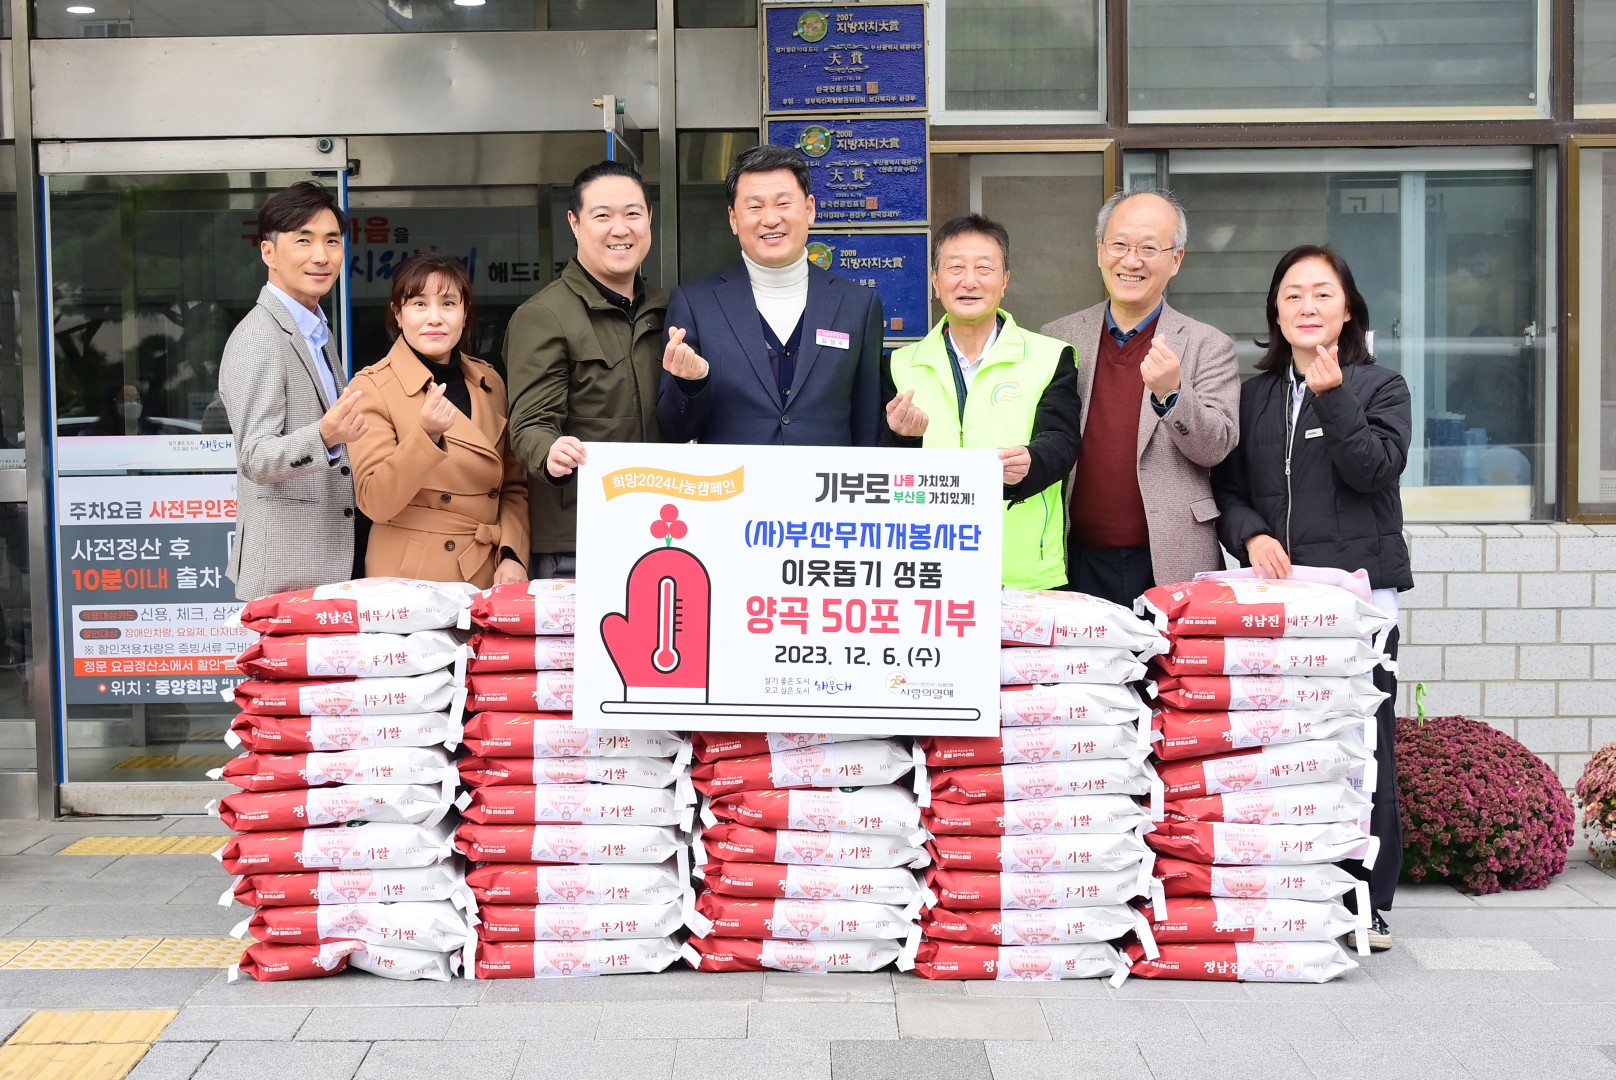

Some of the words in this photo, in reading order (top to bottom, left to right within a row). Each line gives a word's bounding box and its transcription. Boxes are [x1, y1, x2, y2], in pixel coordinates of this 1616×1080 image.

[836, 130, 853, 138] 2008
[840, 249, 857, 257] 2009
[611, 472, 737, 497] 희망2024나눔캠페인
[815, 472, 891, 505] 기부로
[893, 474, 915, 488] 나를
[917, 474, 960, 489] 가치있게
[893, 490, 927, 505] 부산을
[928, 491, 975, 506] 가치있게!
[69, 501, 143, 520] 주차요금
[149, 499, 238, 519] 사전무인정
[744, 519, 982, 552] (사)부산무지개봉사단
[70, 537, 162, 561] 사전정산
[168, 536, 191, 560] 후
[71, 567, 169, 591] 10분이내
[176, 566, 222, 589] 출차
[781, 559, 883, 588] 이웃돕기
[893, 560, 943, 589] 성품
[140, 607, 172, 622] 신용,
[176, 606, 208, 621] 체크,
[315, 612, 354, 625] 정남진
[359, 607, 410, 622] 메뚜기쌀
[745, 595, 810, 635] 양곡
[821, 598, 900, 635] 50포
[914, 599, 977, 638] 기부
[1241, 614, 1280, 628] 정남진
[124, 627, 174, 638] 장애인차량,
[176, 627, 208, 638] 요일제,
[209, 627, 248, 637] 다자녀등
[98, 644, 175, 656] 할인적용차량은
[178, 642, 222, 655] 증빙서류
[774, 644, 833, 665] 2023.
[844, 646, 871, 666] 12.
[83, 660, 107, 673] 정문
[110, 660, 193, 673] 요금정산소에서
[196, 659, 220, 671] 할인
[110, 680, 141, 696] 위치
[154, 679, 218, 695] 중앙현관
[764, 676, 779, 685] 살기
[780, 676, 794, 685] 좋은
[796, 676, 810, 685] 도시
[764, 686, 779, 695] 오고
[796, 686, 810, 695] 도시
[899, 688, 954, 700] 사랑의열매
